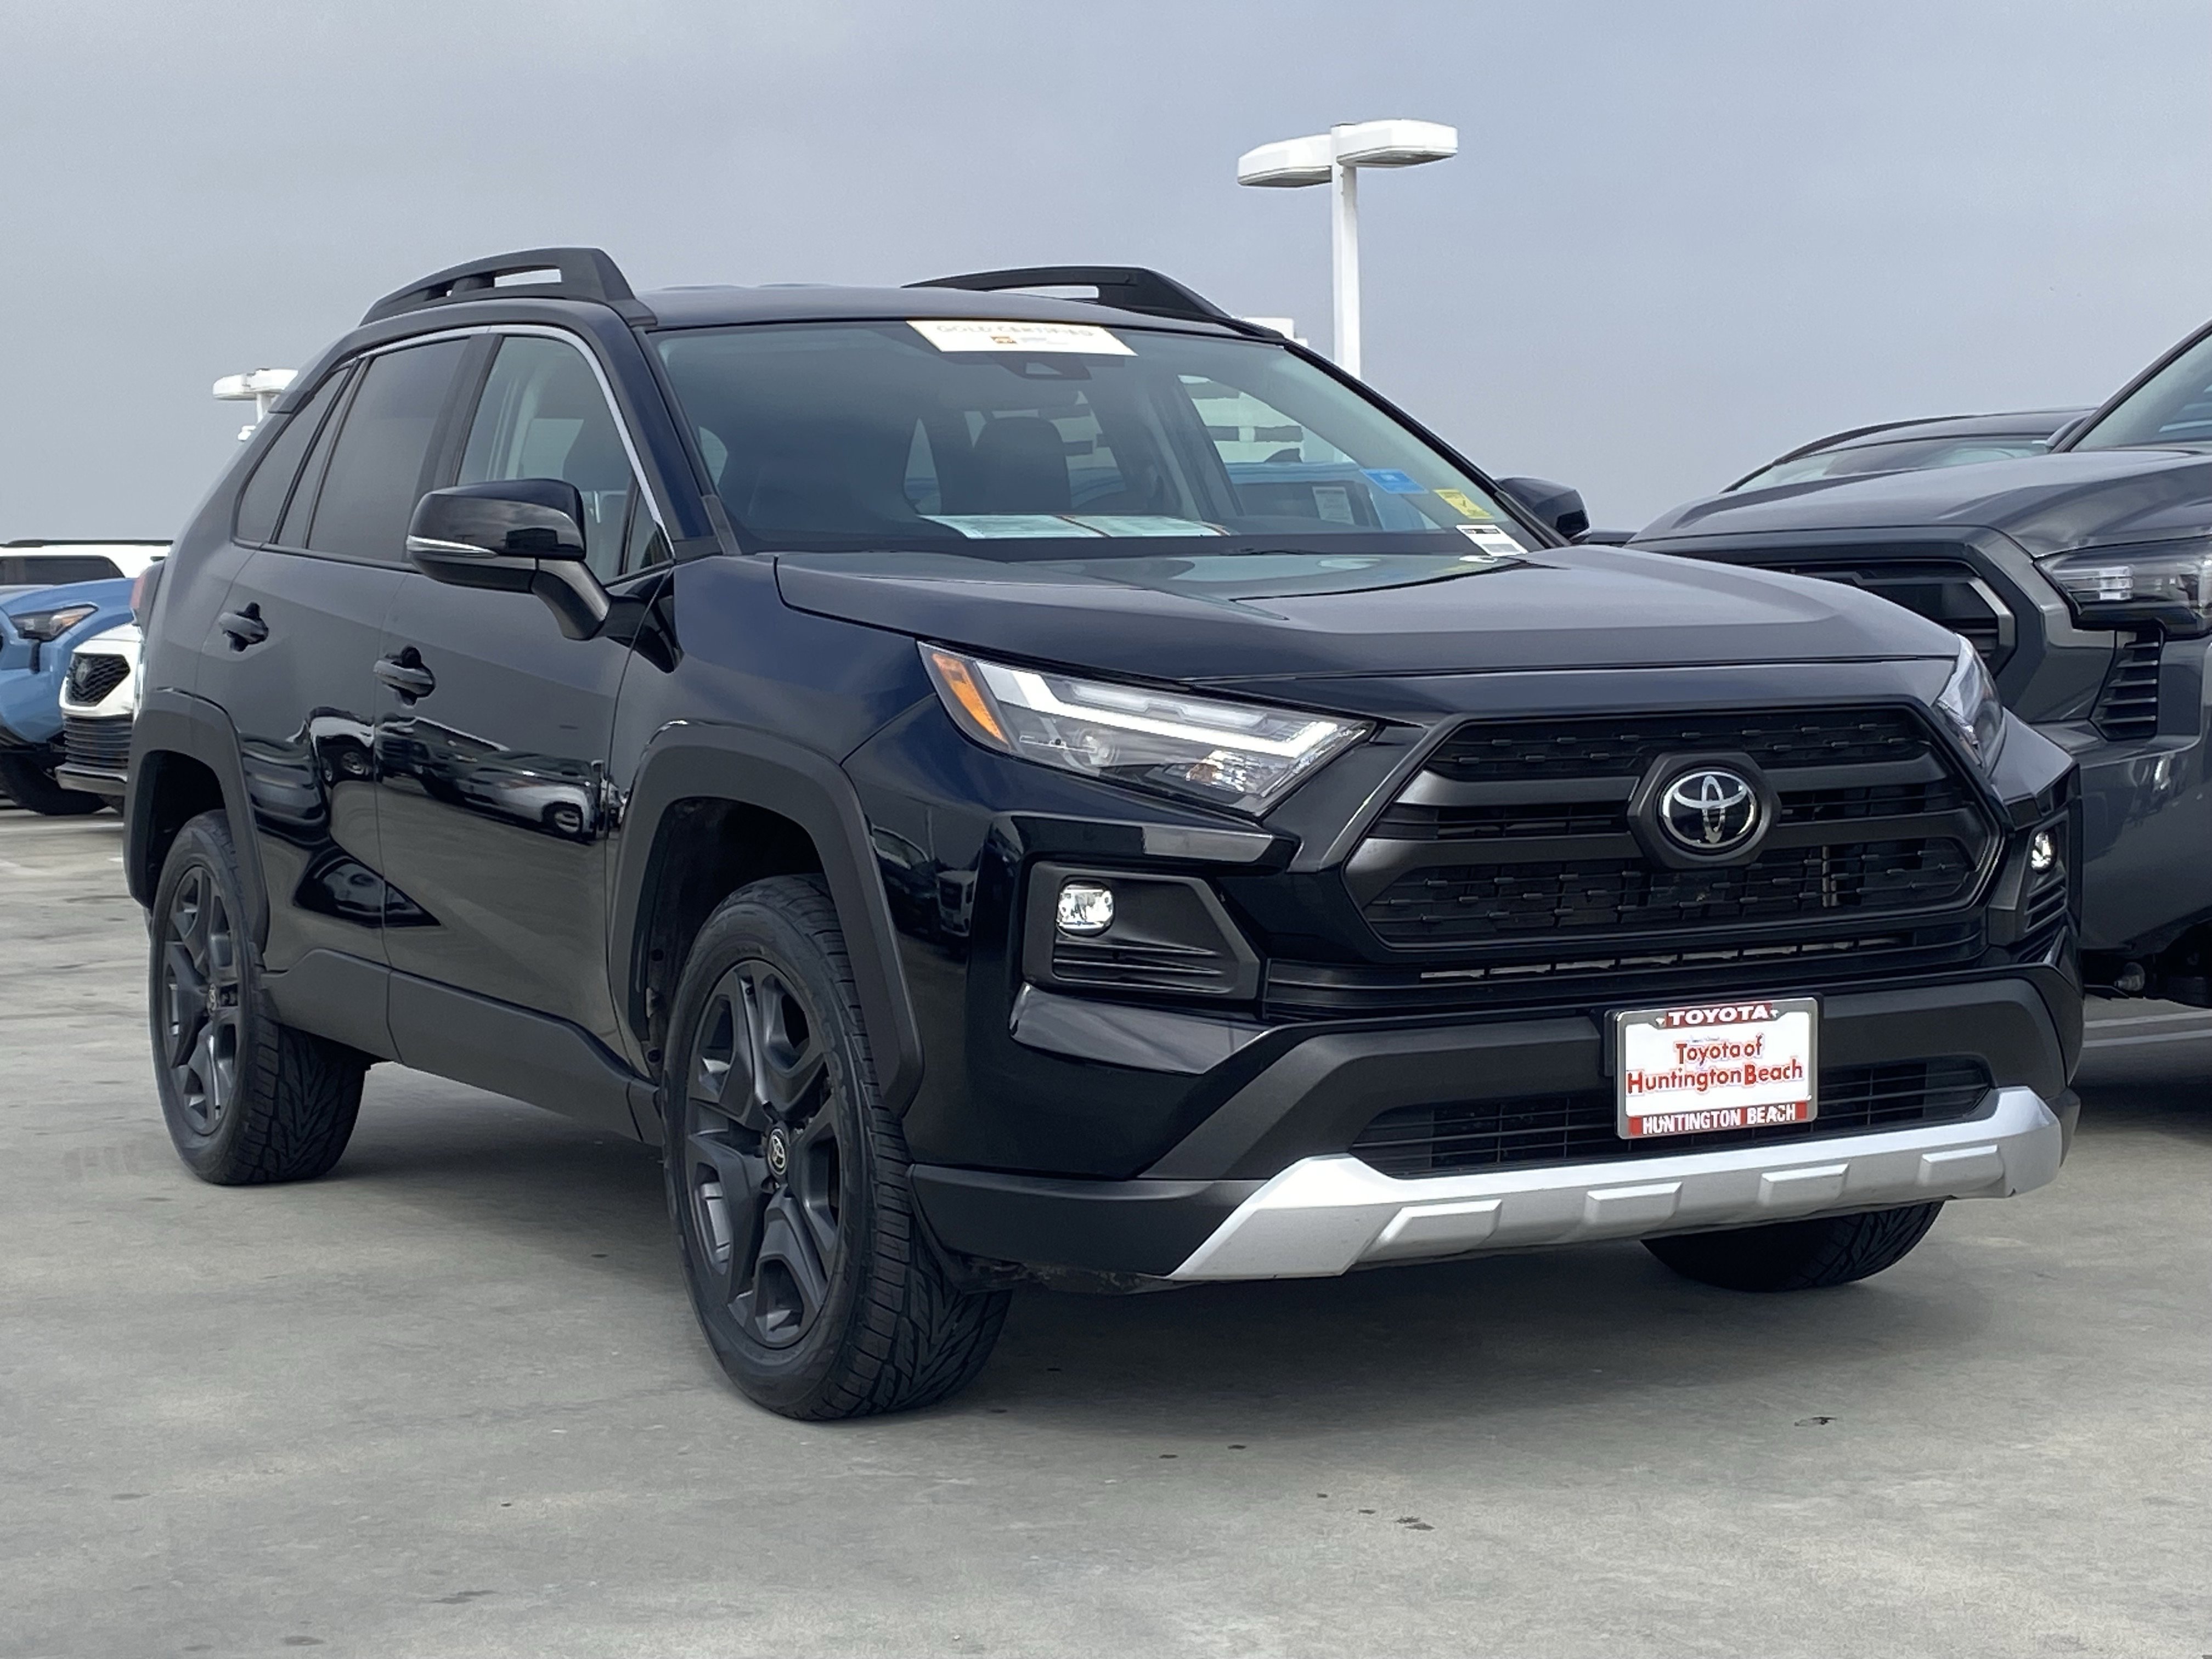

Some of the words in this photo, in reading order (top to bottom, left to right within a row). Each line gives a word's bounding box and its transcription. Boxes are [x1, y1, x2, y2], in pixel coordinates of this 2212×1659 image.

[1668, 1005, 1770, 1025] TOYOTA
[1675, 1041, 1741, 1065] Toyota
[1744, 1034, 1763, 1057] of
[1627, 1067, 1742, 1094] Huntington
[1744, 1058, 1803, 1086] Beach
[1643, 1109, 1741, 1135] HUNTINGTON
[1747, 1103, 1796, 1125] BEACH
